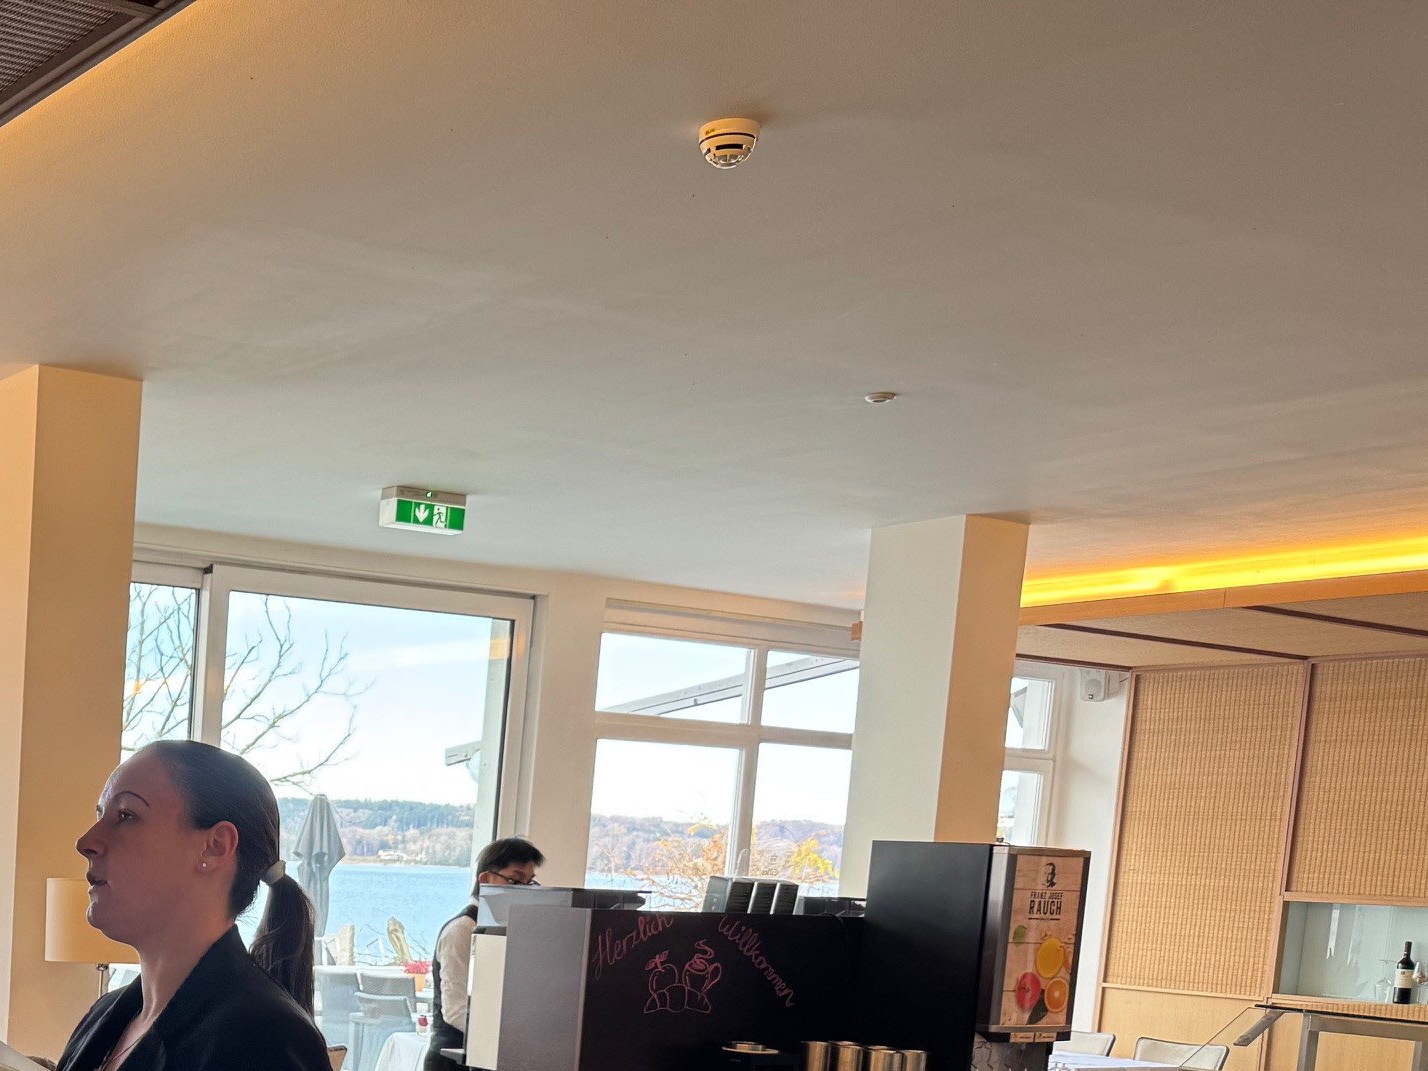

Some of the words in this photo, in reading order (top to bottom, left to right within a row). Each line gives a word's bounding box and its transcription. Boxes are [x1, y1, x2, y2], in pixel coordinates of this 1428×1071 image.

[1028, 900, 1063, 916] RAUCH
[591, 913, 674, 981] Herzlich
[717, 915, 796, 1008] Willkommen
